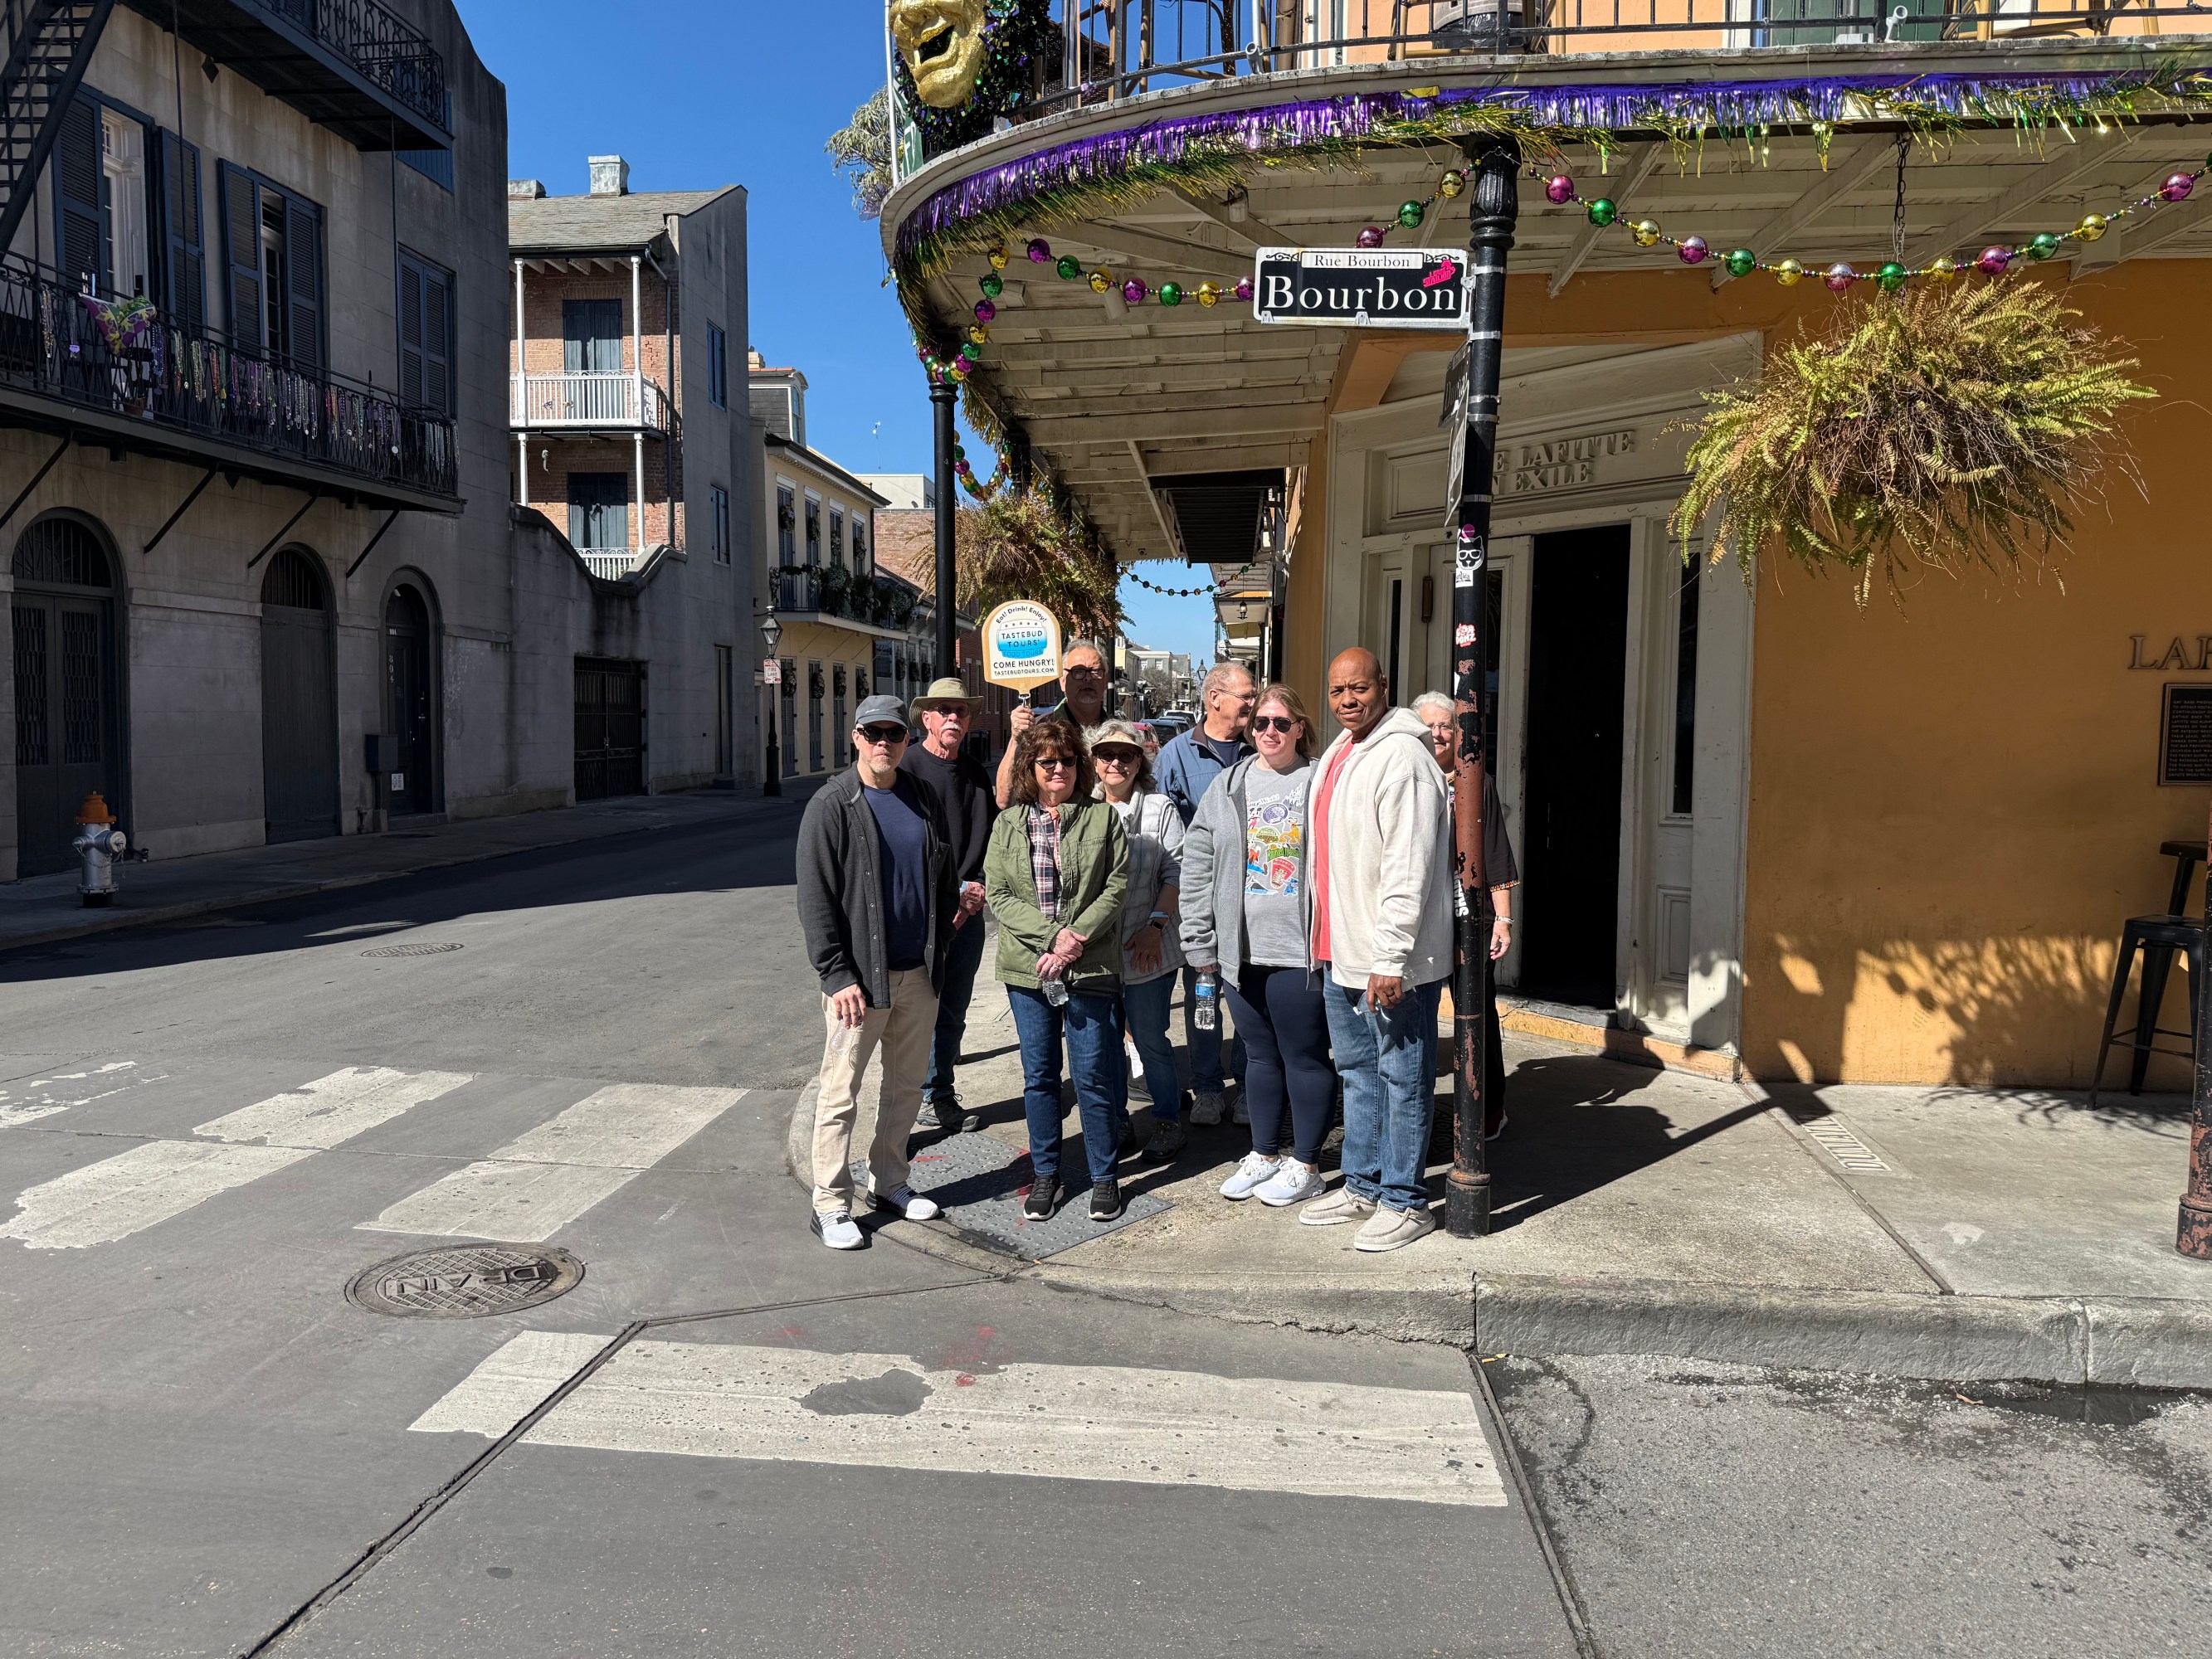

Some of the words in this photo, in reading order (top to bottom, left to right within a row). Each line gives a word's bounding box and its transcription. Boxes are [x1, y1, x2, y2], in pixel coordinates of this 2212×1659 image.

[1314, 255, 1342, 266] Rue
[1347, 255, 1411, 267] Bourbon
[1263, 275, 1457, 310] Bourbon
[1516, 431, 1635, 469] LAFITTE
[1513, 460, 1593, 492] EXILE
[996, 611, 1007, 624] Eat!
[1007, 606, 1028, 615] Drink!
[1029, 607, 1047, 622] Enjoy!
[1001, 630, 1043, 640] TASTEBUD
[1007, 640, 1038, 648] TOURS
[993, 660, 1016, 669] COME
[1018, 658, 1055, 667] HUNGRY!
[994, 668, 1055, 676] TASTEBUDTOURS.COM
[1791, 1112, 1893, 1171] DUMAINE
[396, 1266, 541, 1294] DRAIN
